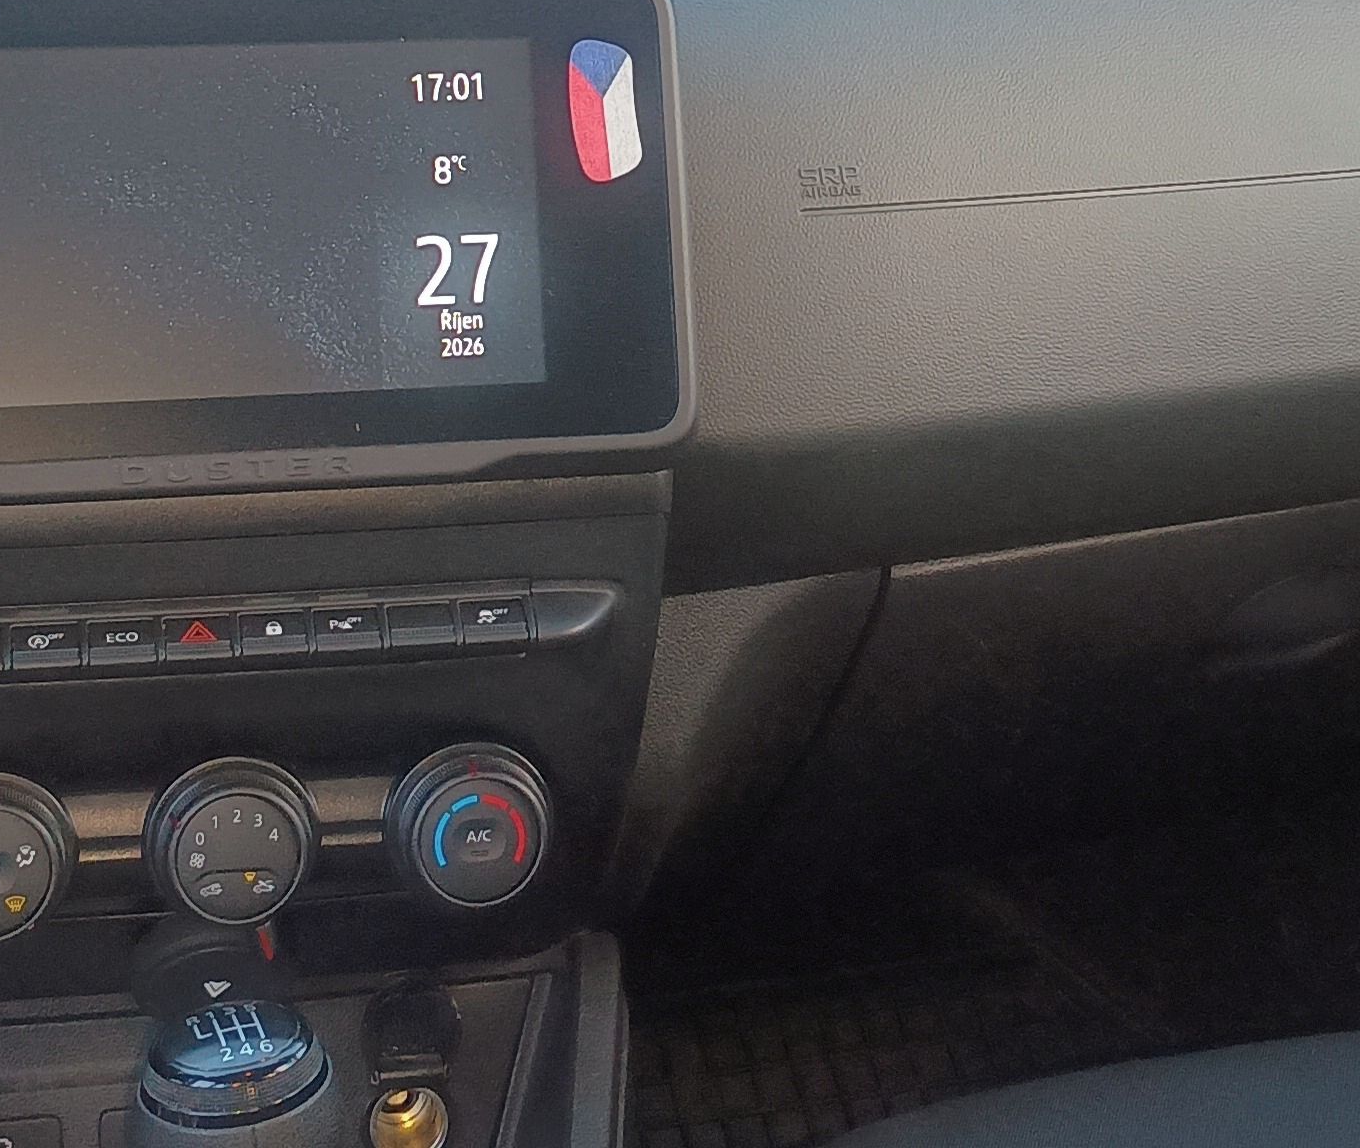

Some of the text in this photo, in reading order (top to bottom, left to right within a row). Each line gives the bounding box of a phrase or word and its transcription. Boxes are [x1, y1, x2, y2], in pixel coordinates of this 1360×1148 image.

[410, 72, 484, 102] 17:01
[415, 233, 500, 306] 27
[440, 308, 484, 334] Říjen
[440, 337, 485, 358] 2026
[120, 455, 352, 486] DUSTER
[105, 631, 139, 644] ECO
[195, 809, 279, 845] 0 1 2 3 4
[466, 829, 492, 844] A/C
[220, 1039, 274, 1062] 2 4 6
